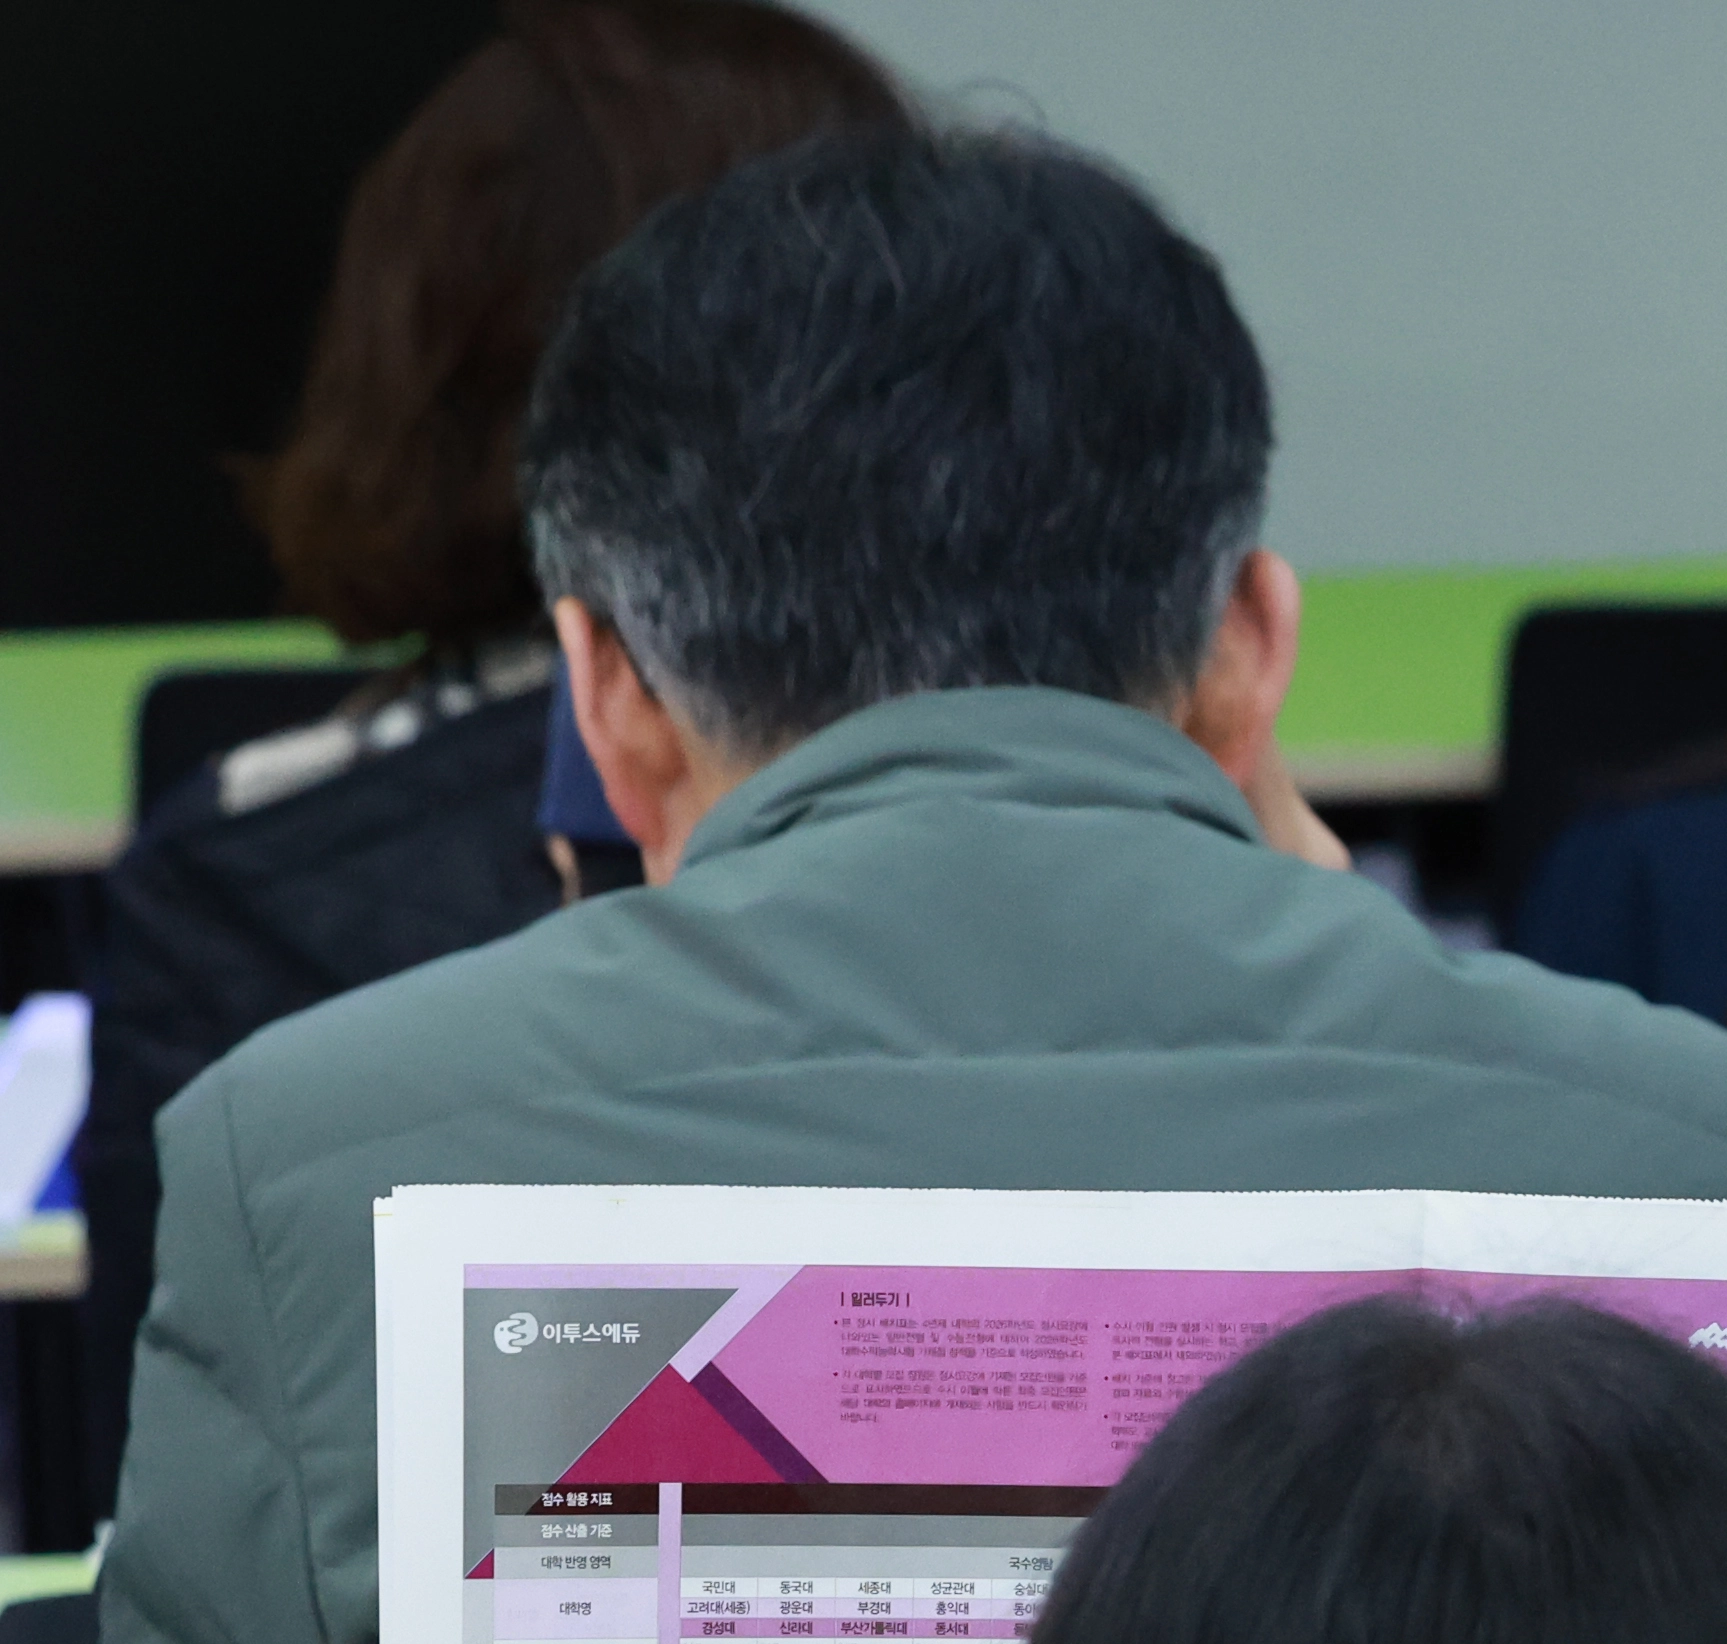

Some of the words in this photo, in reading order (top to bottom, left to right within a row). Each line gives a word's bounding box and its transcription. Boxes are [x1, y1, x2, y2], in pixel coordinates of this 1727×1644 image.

[851, 1292, 900, 1307] 일러두기
[542, 1322, 641, 1345] 이투스에듀
[541, 1492, 564, 1508] 점수
[566, 1492, 588, 1507] 활용
[590, 1492, 613, 1507] 지표
[541, 1524, 563, 1539] 점수
[565, 1524, 588, 1538] 산출
[590, 1524, 613, 1538] 기준
[541, 1555, 562, 1569] 대학
[565, 1555, 588, 1569] 반영
[589, 1555, 611, 1569] 영역
[702, 1581, 736, 1595] 국민대
[779, 1581, 814, 1595] 동국대
[858, 1581, 892, 1596] 세종대
[930, 1582, 975, 1596] 성균관대
[686, 1601, 751, 1616] 고려대(세종)
[779, 1601, 814, 1616] 광운대
[857, 1601, 891, 1616] 부경대
[935, 1601, 970, 1616] 홍익대
[702, 1621, 736, 1636] 경성대
[779, 1621, 814, 1636] 신라대
[840, 1621, 908, 1636] 부산가톨릭대
